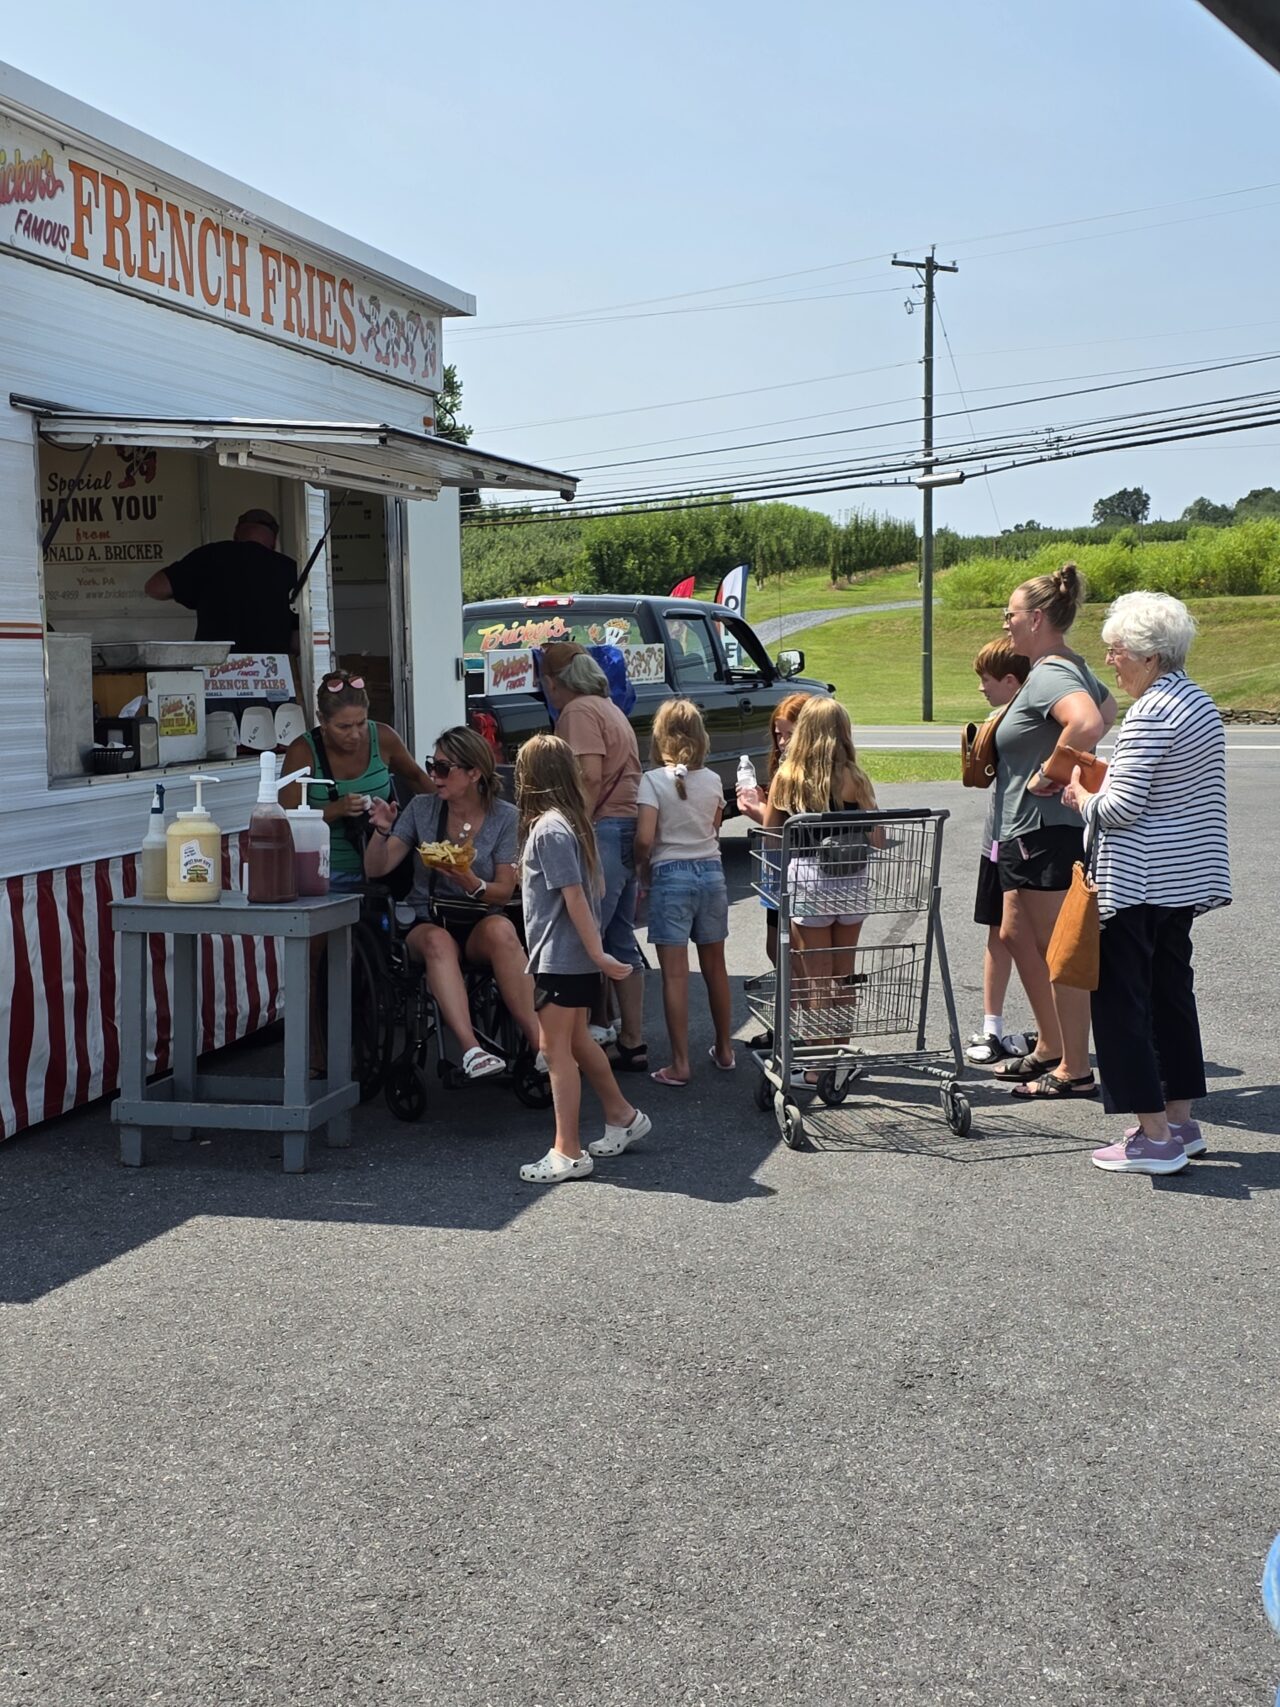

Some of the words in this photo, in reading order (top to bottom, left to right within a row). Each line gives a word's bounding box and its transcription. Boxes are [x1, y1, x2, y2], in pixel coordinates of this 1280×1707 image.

[15, 208, 70, 252] FAMOUS
[68, 159, 250, 317] FRENCH
[259, 243, 356, 355] FRIES
[47, 470, 112, 495] Special
[76, 528, 111, 543] from
[88, 545, 101, 561] A.
[105, 544, 163, 561] BRICKER
[102, 577, 115, 585] PA
[478, 616, 571, 651] Bricker's
[205, 679, 249, 690] FRENCH
[253, 679, 287, 690] FRIES
